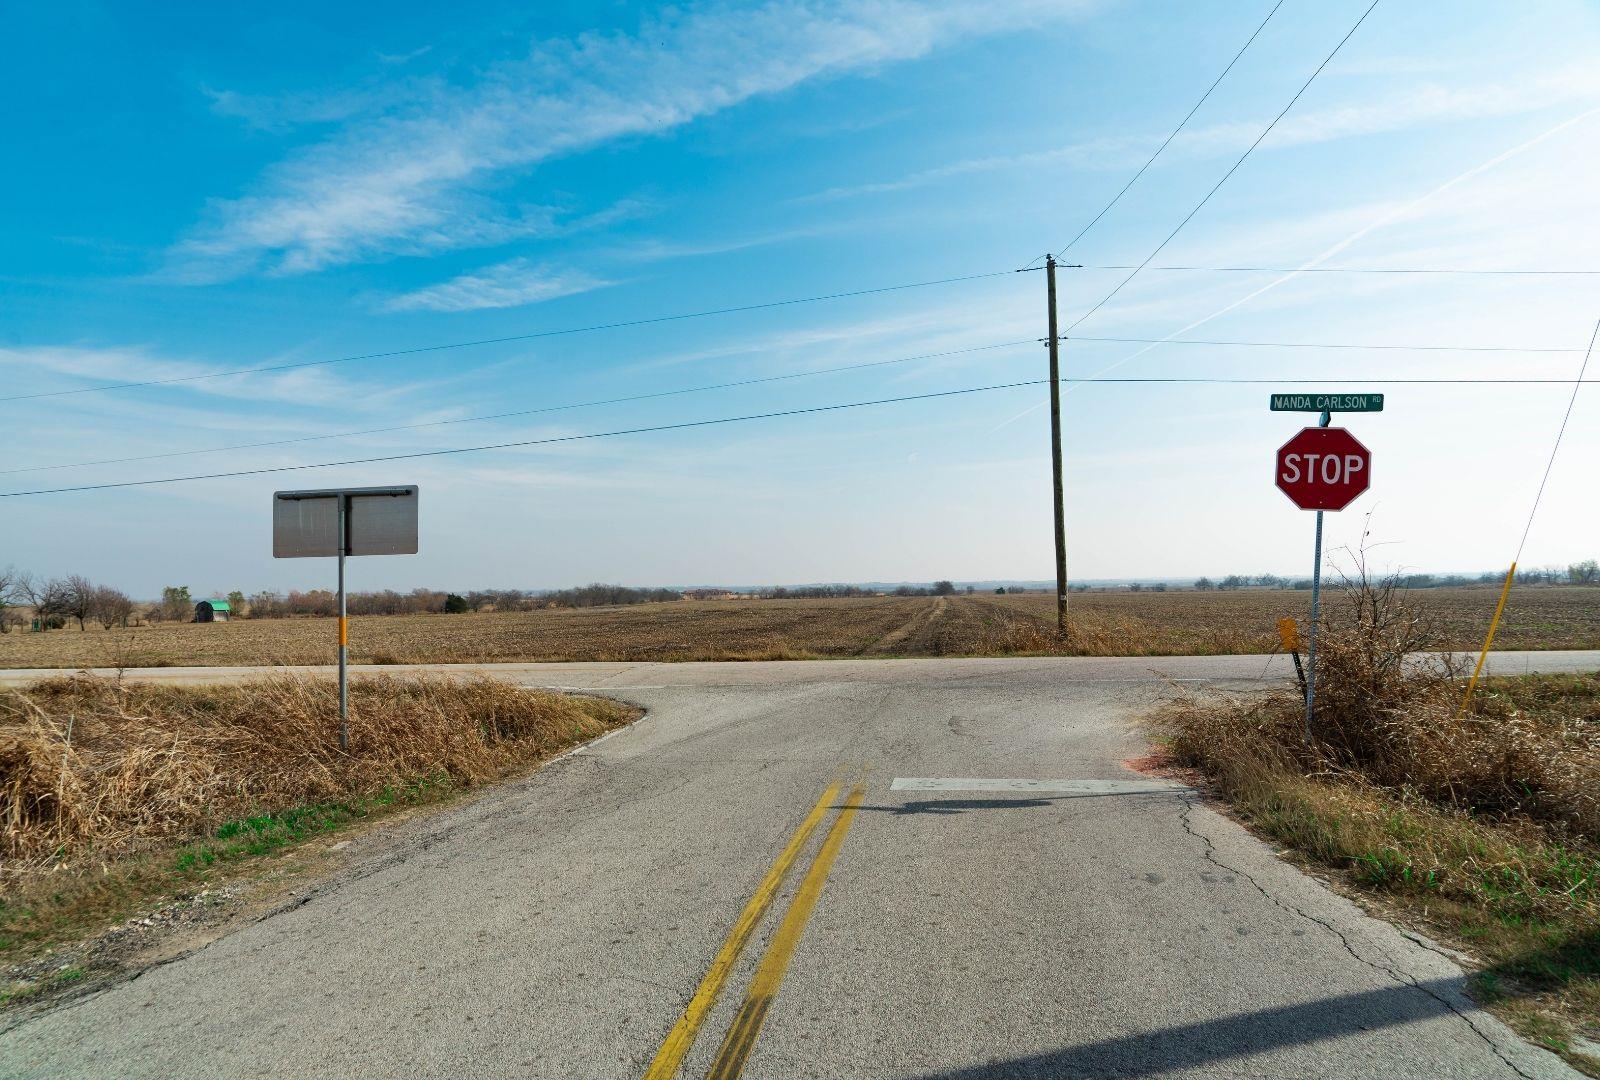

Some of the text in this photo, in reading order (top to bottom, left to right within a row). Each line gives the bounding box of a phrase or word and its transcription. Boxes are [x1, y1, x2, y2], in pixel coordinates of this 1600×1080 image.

[1274, 395, 1381, 409] MANDA CARLSON RD
[1282, 453, 1364, 485] STOP
